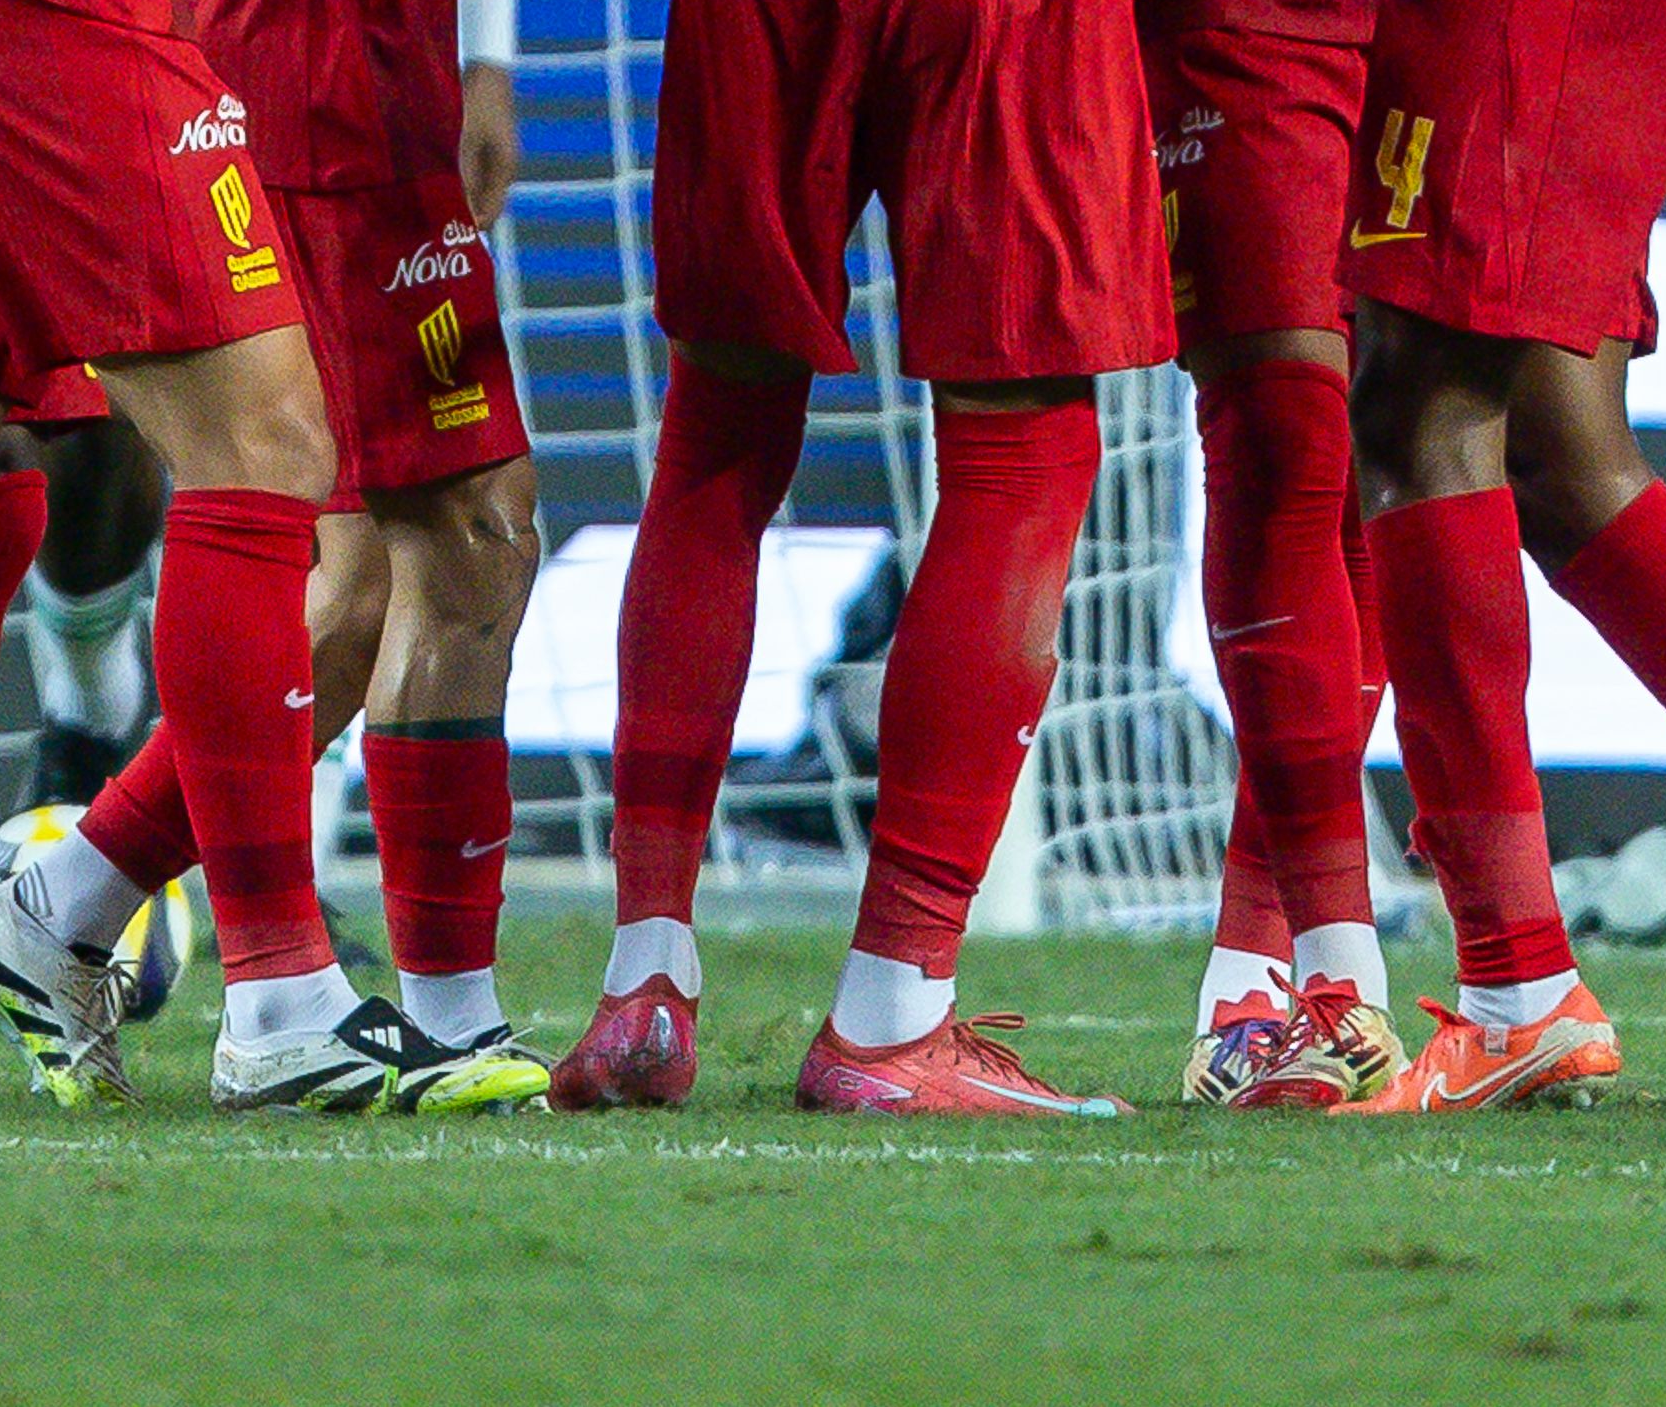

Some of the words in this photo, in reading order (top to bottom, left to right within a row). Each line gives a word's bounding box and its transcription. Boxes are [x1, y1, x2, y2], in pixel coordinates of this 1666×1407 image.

[169, 108, 248, 156] Nova
[1375, 107, 1436, 230] 4
[381, 239, 473, 293] Nova
